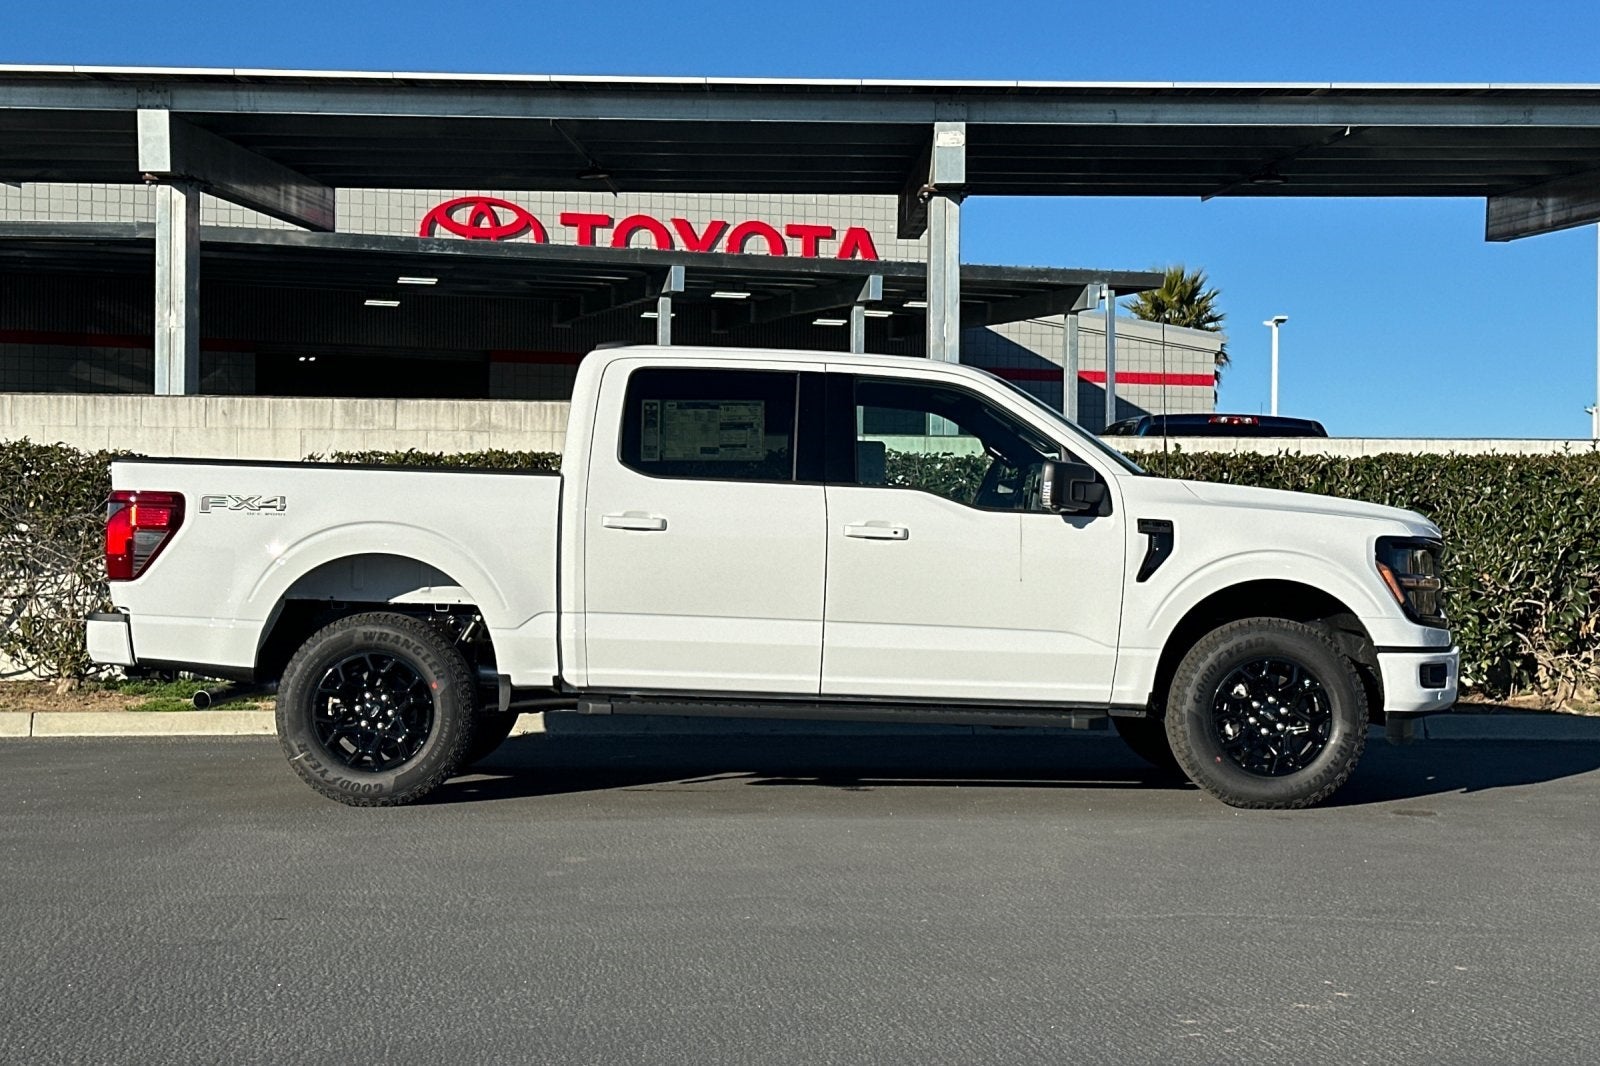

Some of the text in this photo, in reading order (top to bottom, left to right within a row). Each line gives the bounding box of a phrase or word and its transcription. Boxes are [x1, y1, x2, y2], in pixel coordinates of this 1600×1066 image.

[560, 212, 879, 261] TOYOTA
[199, 495, 286, 513] FX4
[363, 631, 446, 680] WRANGLER
[1193, 637, 1266, 704] GOODYEAR
[297, 743, 383, 793] GOODYEAR
